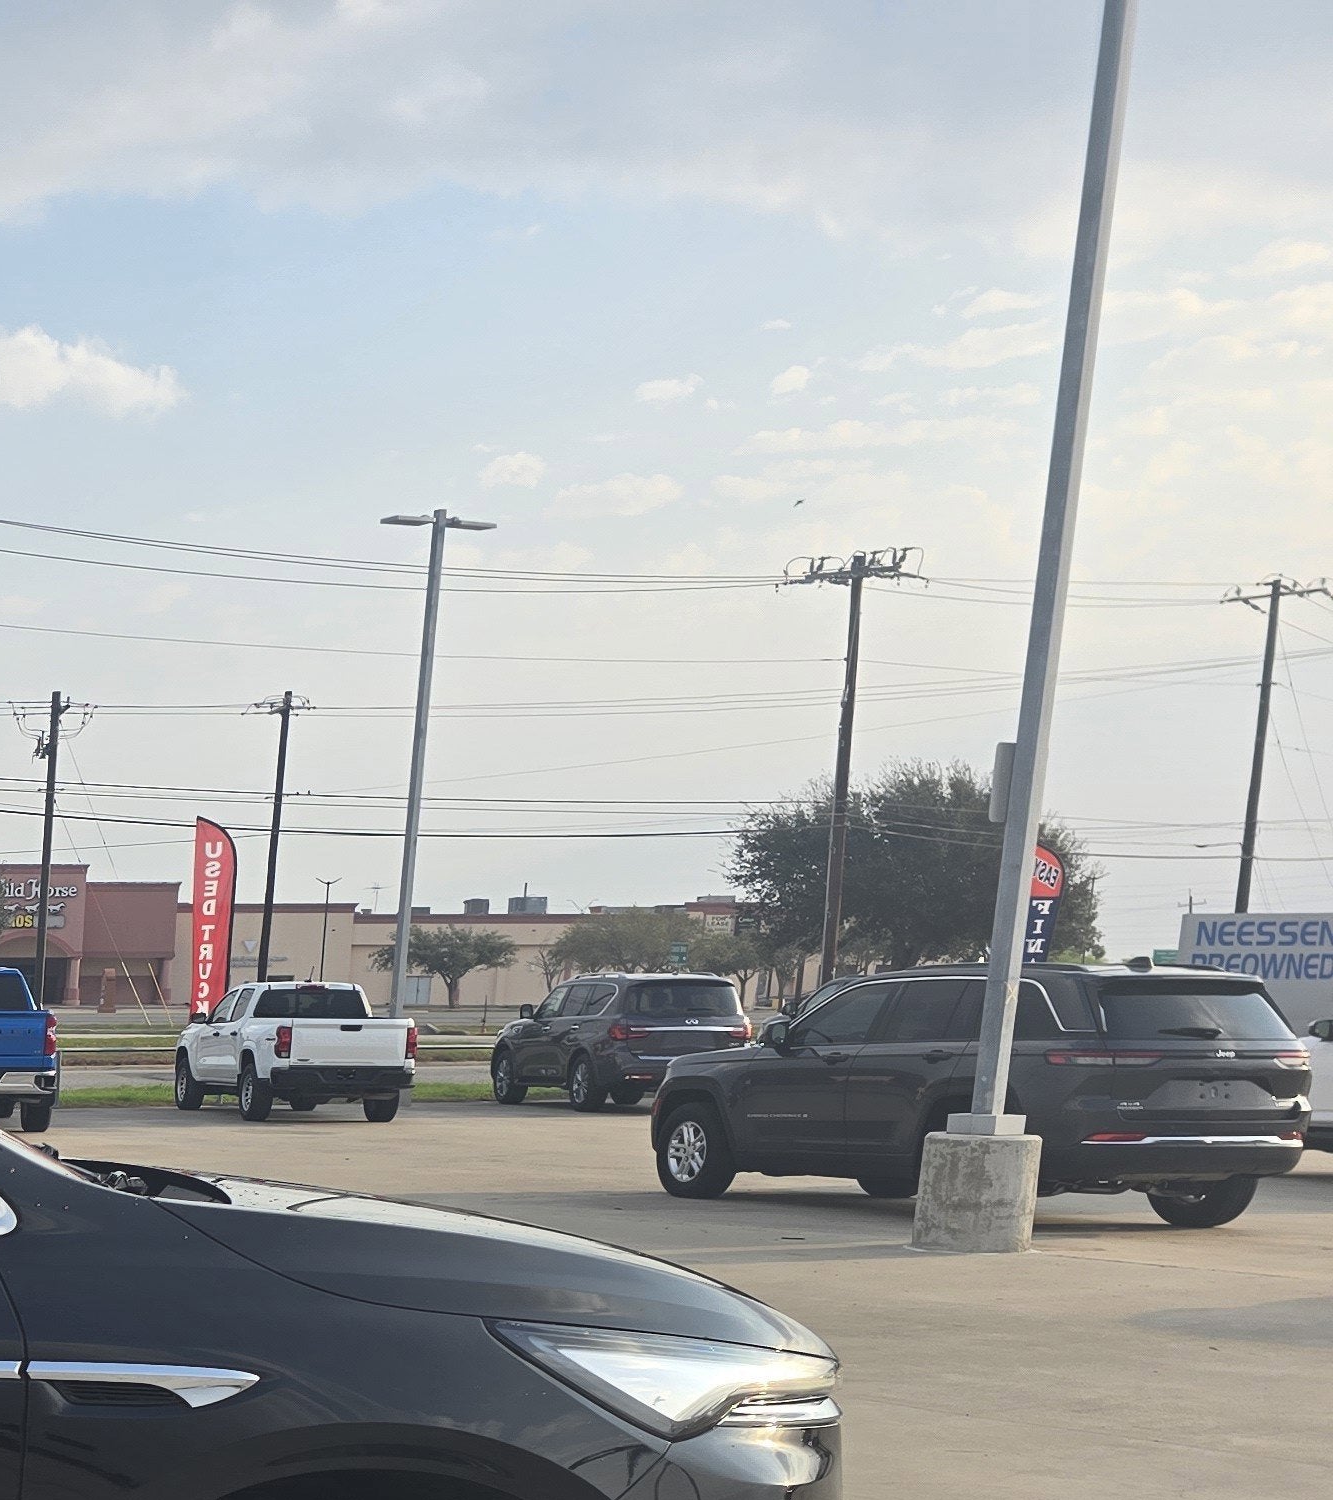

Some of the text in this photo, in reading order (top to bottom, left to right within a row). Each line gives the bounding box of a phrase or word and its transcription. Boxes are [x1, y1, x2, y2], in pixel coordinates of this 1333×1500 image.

[1, 879, 78, 900] ild Horse
[1195, 921, 1333, 947] NEESSEN
